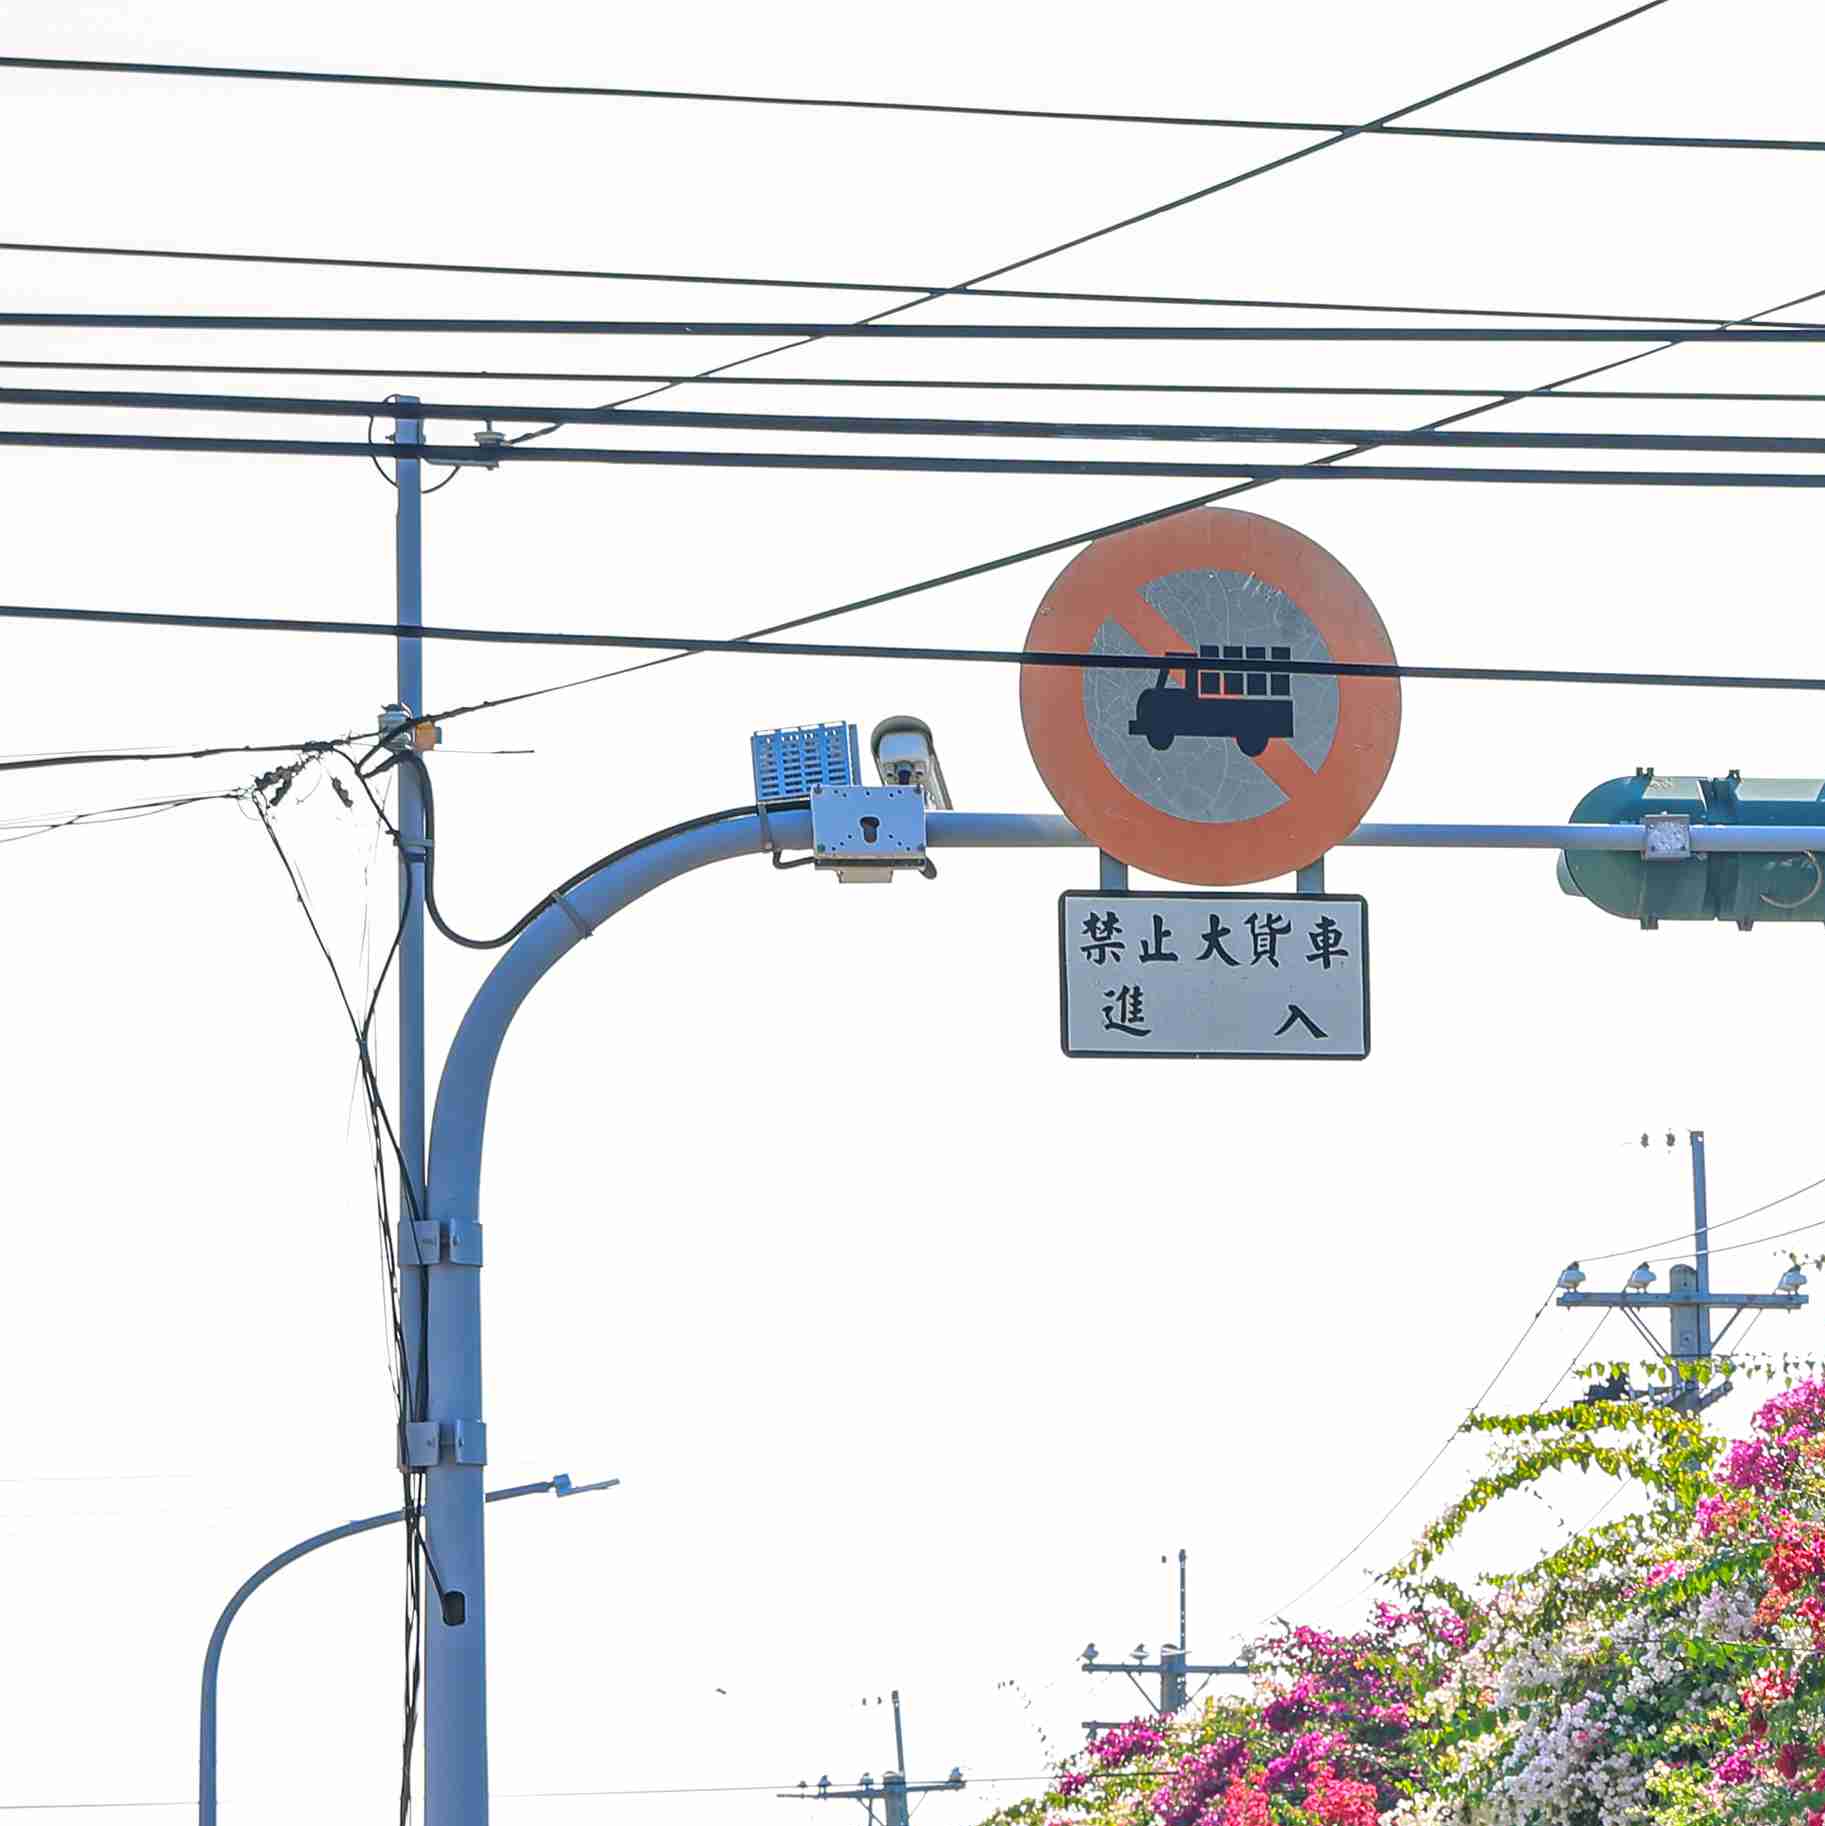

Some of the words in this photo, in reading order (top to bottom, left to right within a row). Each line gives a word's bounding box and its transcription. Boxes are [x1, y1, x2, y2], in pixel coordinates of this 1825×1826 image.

[1080, 911, 1349, 969] 禁止大貨車
